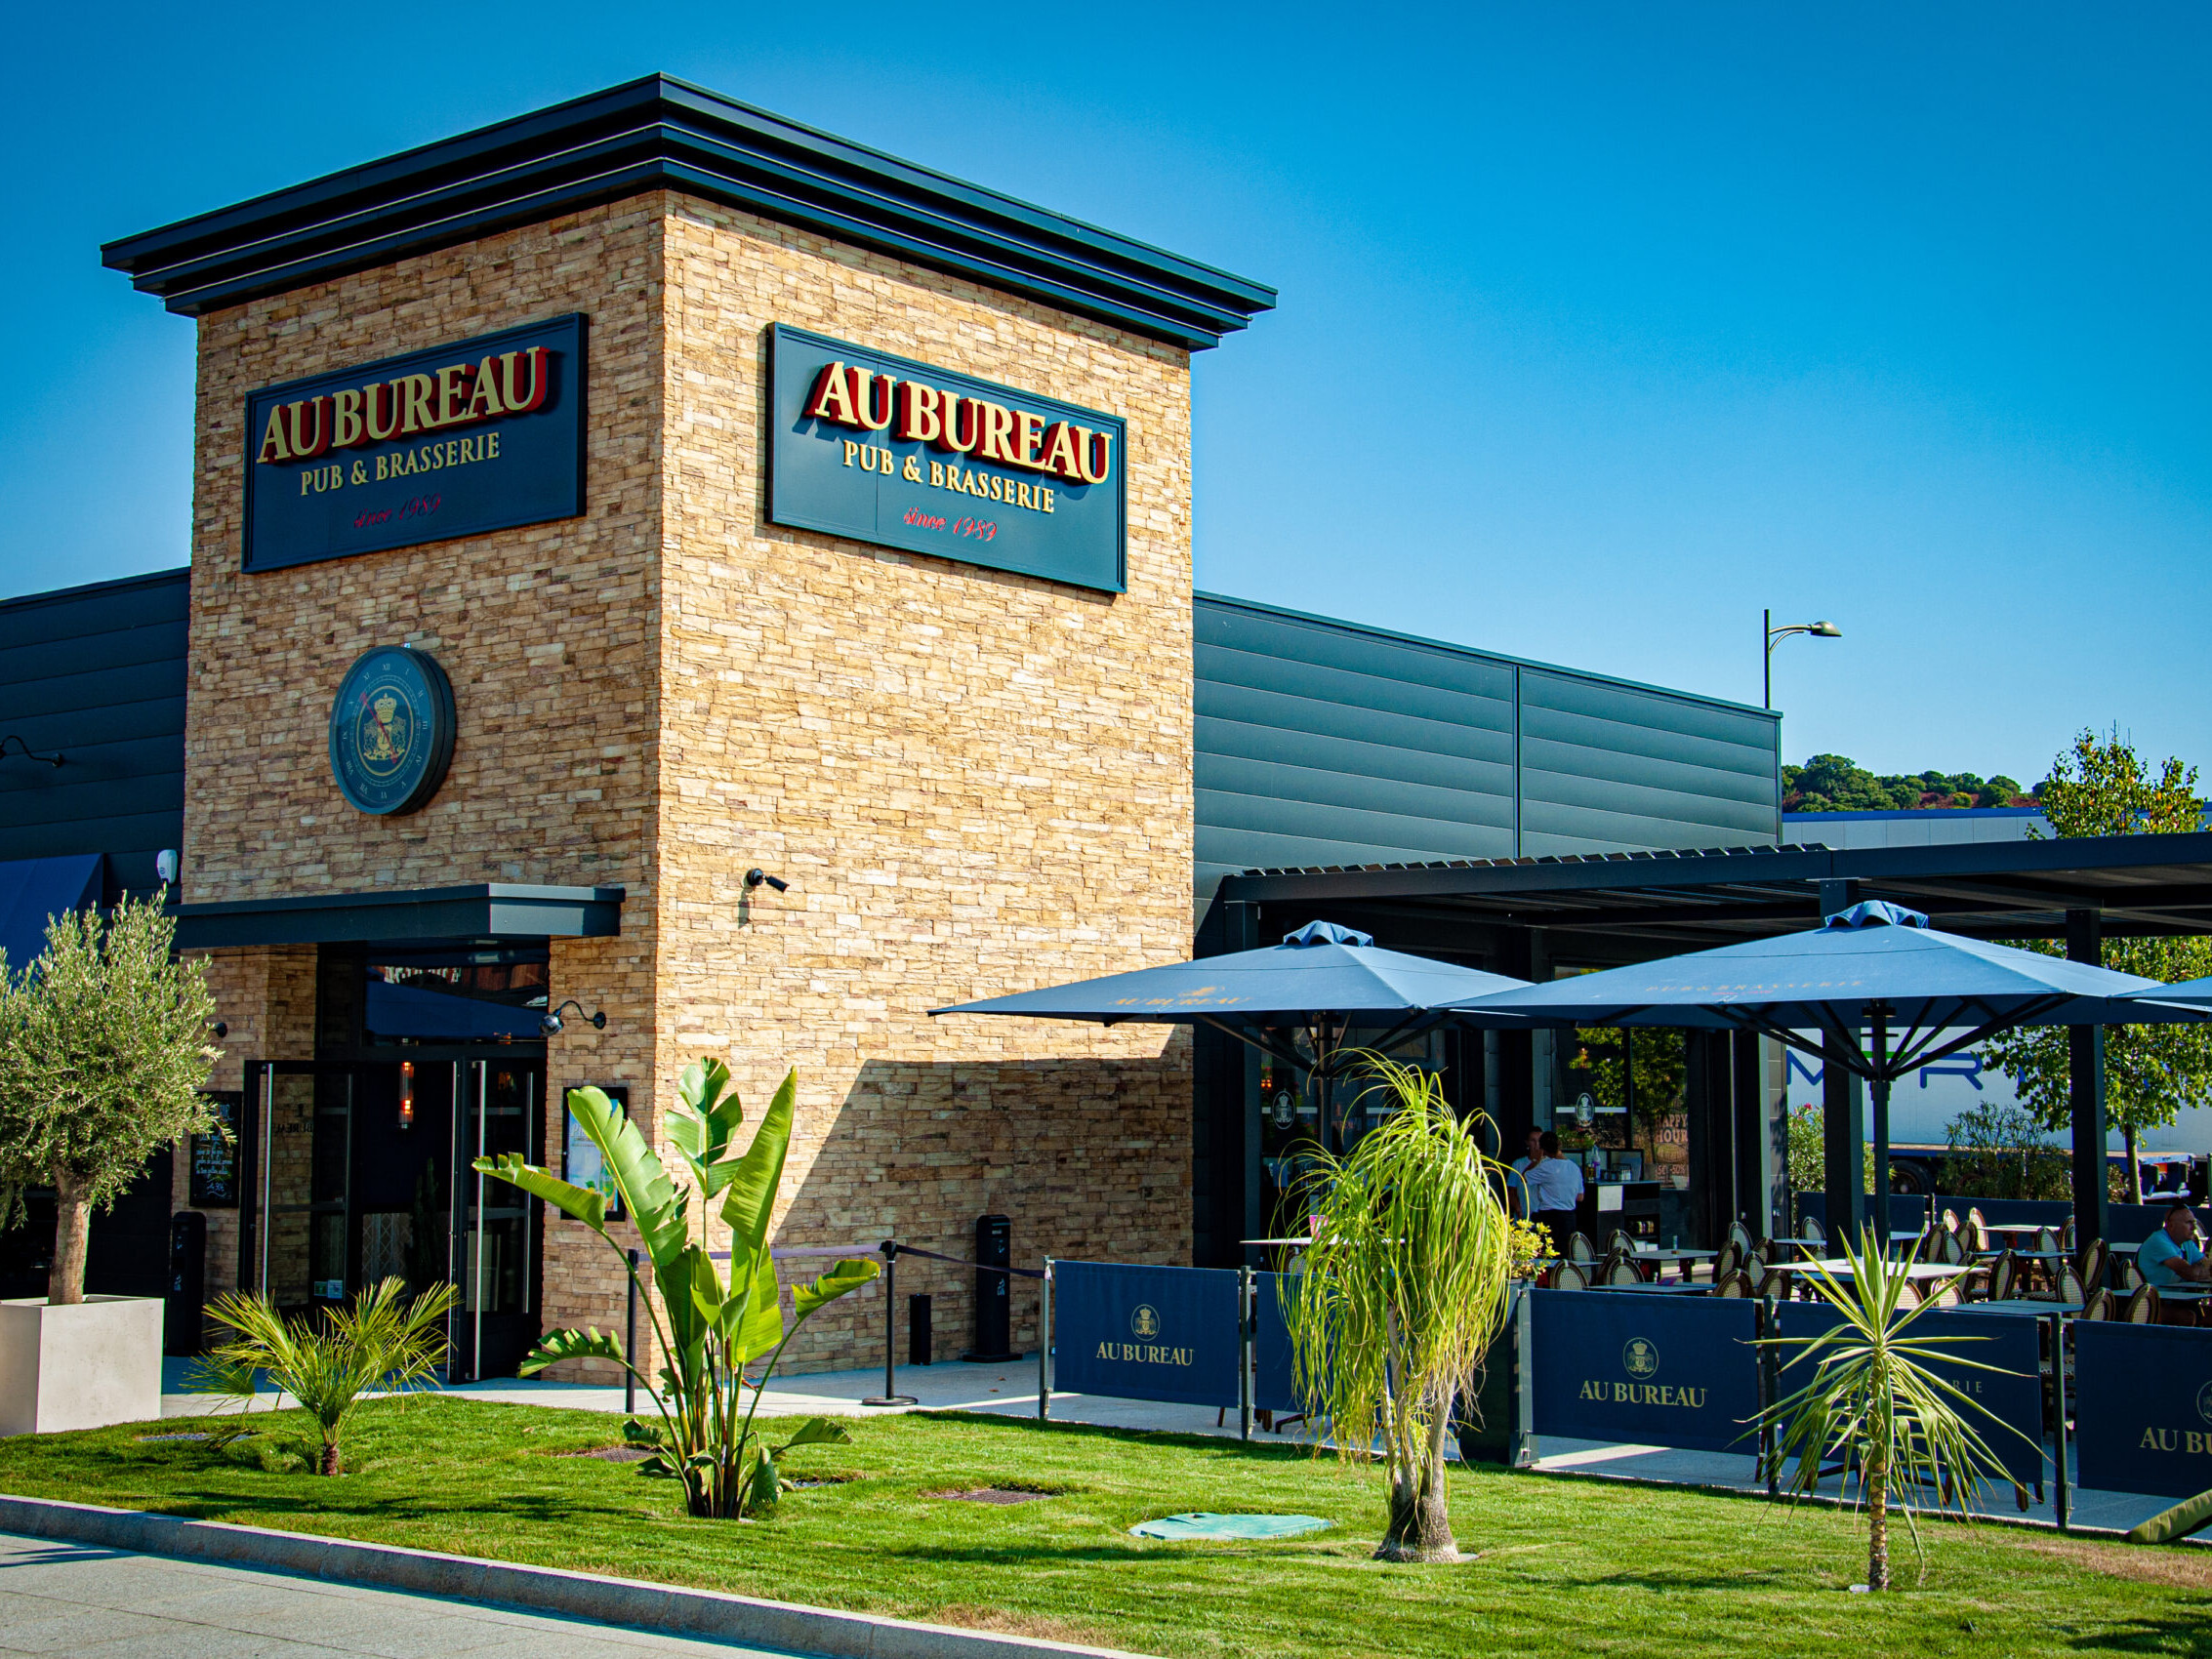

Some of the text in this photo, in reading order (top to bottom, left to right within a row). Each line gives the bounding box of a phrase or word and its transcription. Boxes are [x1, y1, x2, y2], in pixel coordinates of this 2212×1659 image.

[257, 346, 547, 465] AU BUREAU
[808, 361, 1113, 485] AU BUREAU
[301, 432, 501, 496] PUB & BRASSERIE
[843, 439, 1054, 513] PUB & BRASSERIE
[398, 493, 441, 520] 1989
[904, 506, 998, 542] since 1989
[1655, 1113, 1688, 1127] HAPPY
[1655, 1128, 1688, 1143] HOUR
[1096, 1342, 1194, 1366] AU BUREAU
[1579, 1380, 1706, 1407] AU BUREAU
[2139, 1427, 2178, 1451] AU
